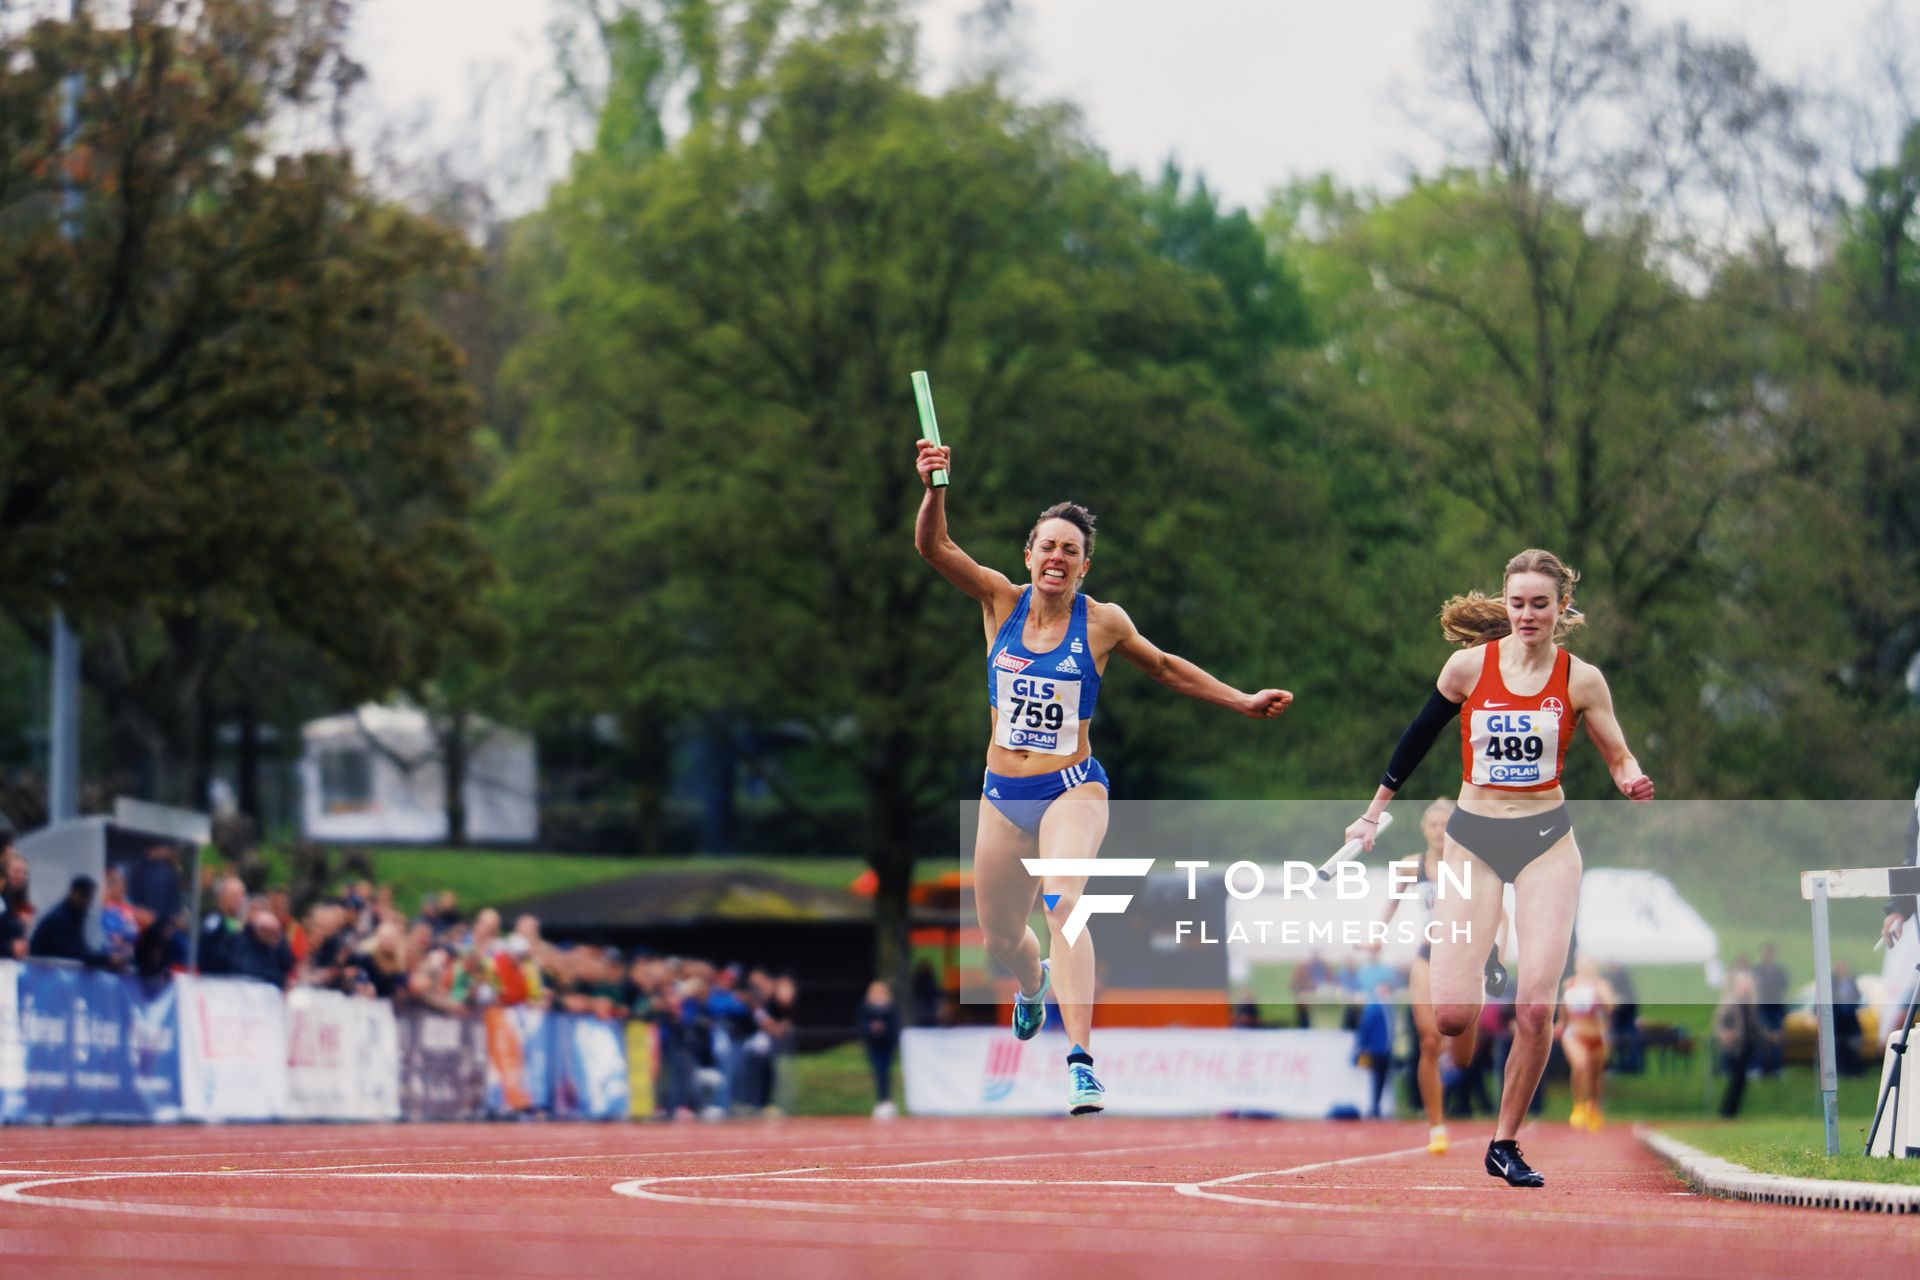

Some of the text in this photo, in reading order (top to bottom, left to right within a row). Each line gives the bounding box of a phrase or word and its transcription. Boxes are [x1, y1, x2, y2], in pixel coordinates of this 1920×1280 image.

[1010, 697, 1063, 730] 759
[1028, 733, 1056, 744] PLAN
[1485, 736, 1543, 762] 489
[1510, 767, 1538, 777] PLAN
